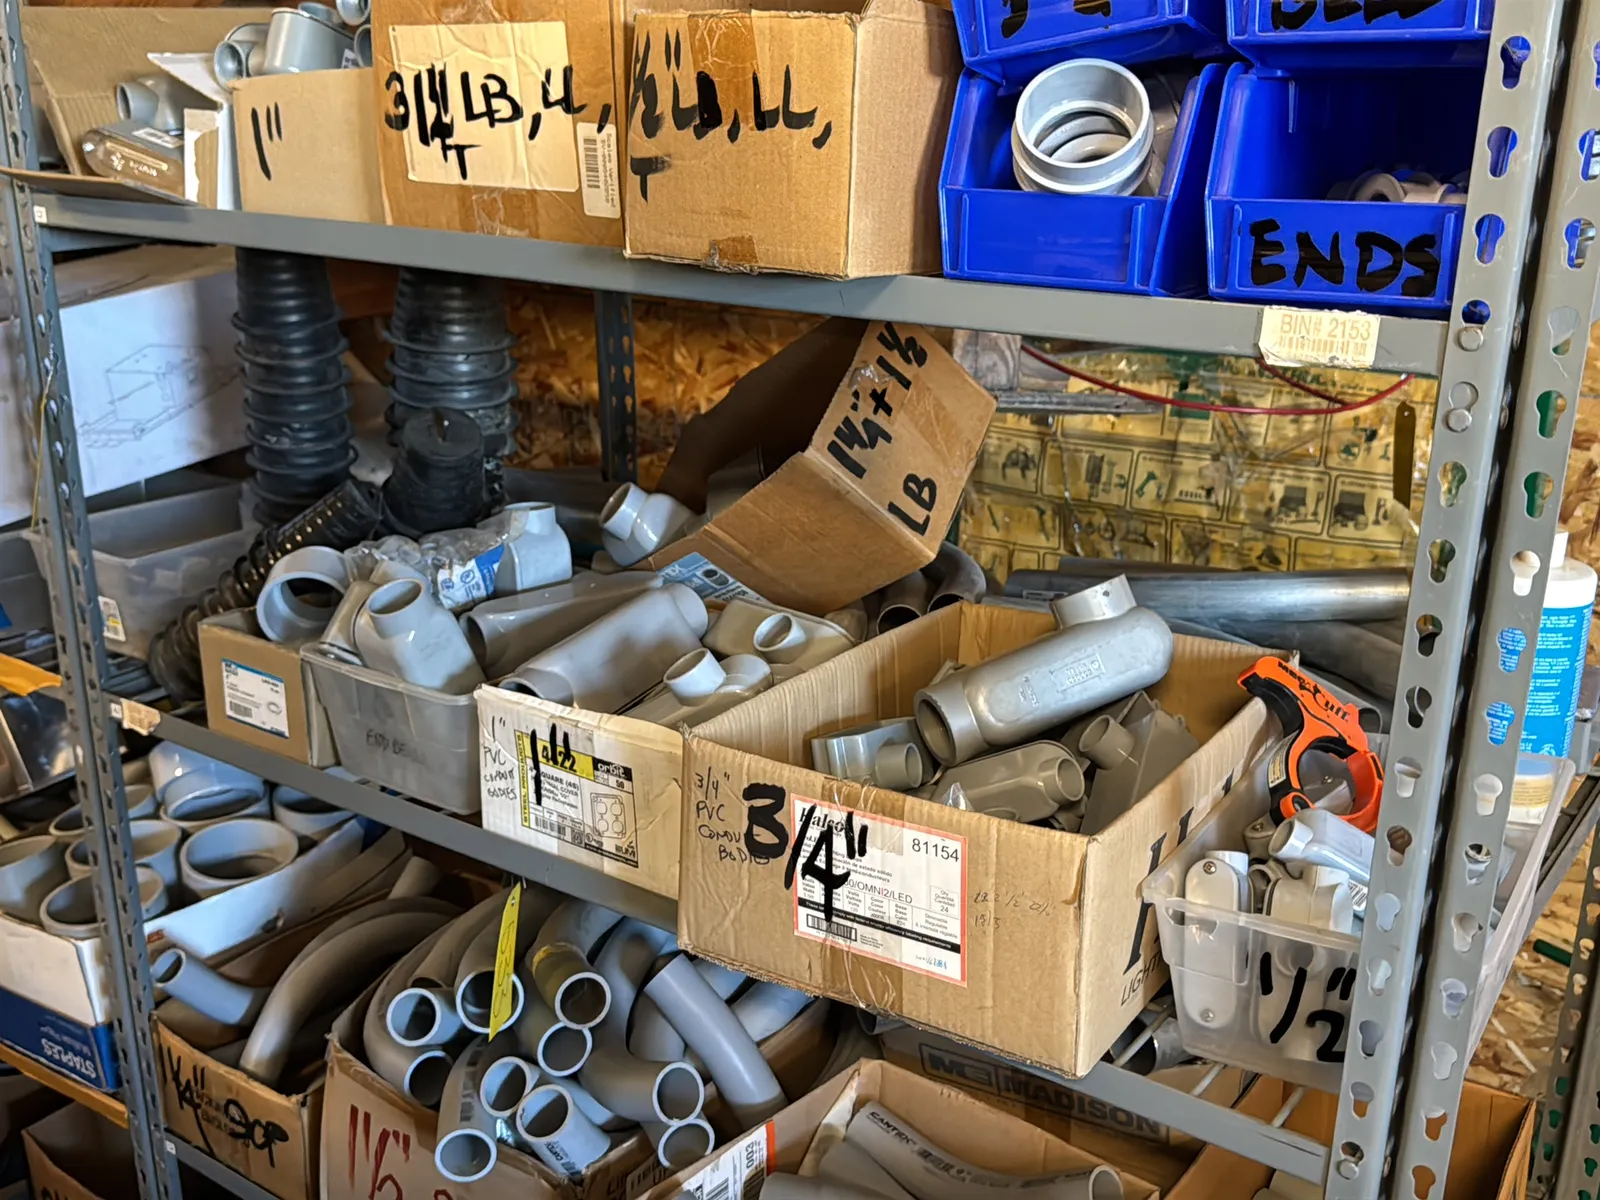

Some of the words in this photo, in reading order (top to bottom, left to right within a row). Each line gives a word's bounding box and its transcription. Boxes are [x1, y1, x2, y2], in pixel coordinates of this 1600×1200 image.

[250, 102, 282, 180] 1"
[629, 153, 673, 203] T
[1250, 218, 1441, 297] ENDS
[1280, 313, 1323, 335] BIN#
[1327, 317, 1372, 341] 2153
[888, 473, 938, 536] LB
[483, 745, 507, 768] PVC
[540, 744, 577, 773] 422
[597, 761, 627, 778] orbit
[694, 766, 731, 801] 3/4"
[695, 800, 726, 822] PVC
[911, 837, 959, 863] 81154
[940, 905, 949, 913] 24
[1257, 950, 1357, 1063] 1/2"
[41, 1037, 97, 1079] STAPLES
[745, 1141, 756, 1170] 003
